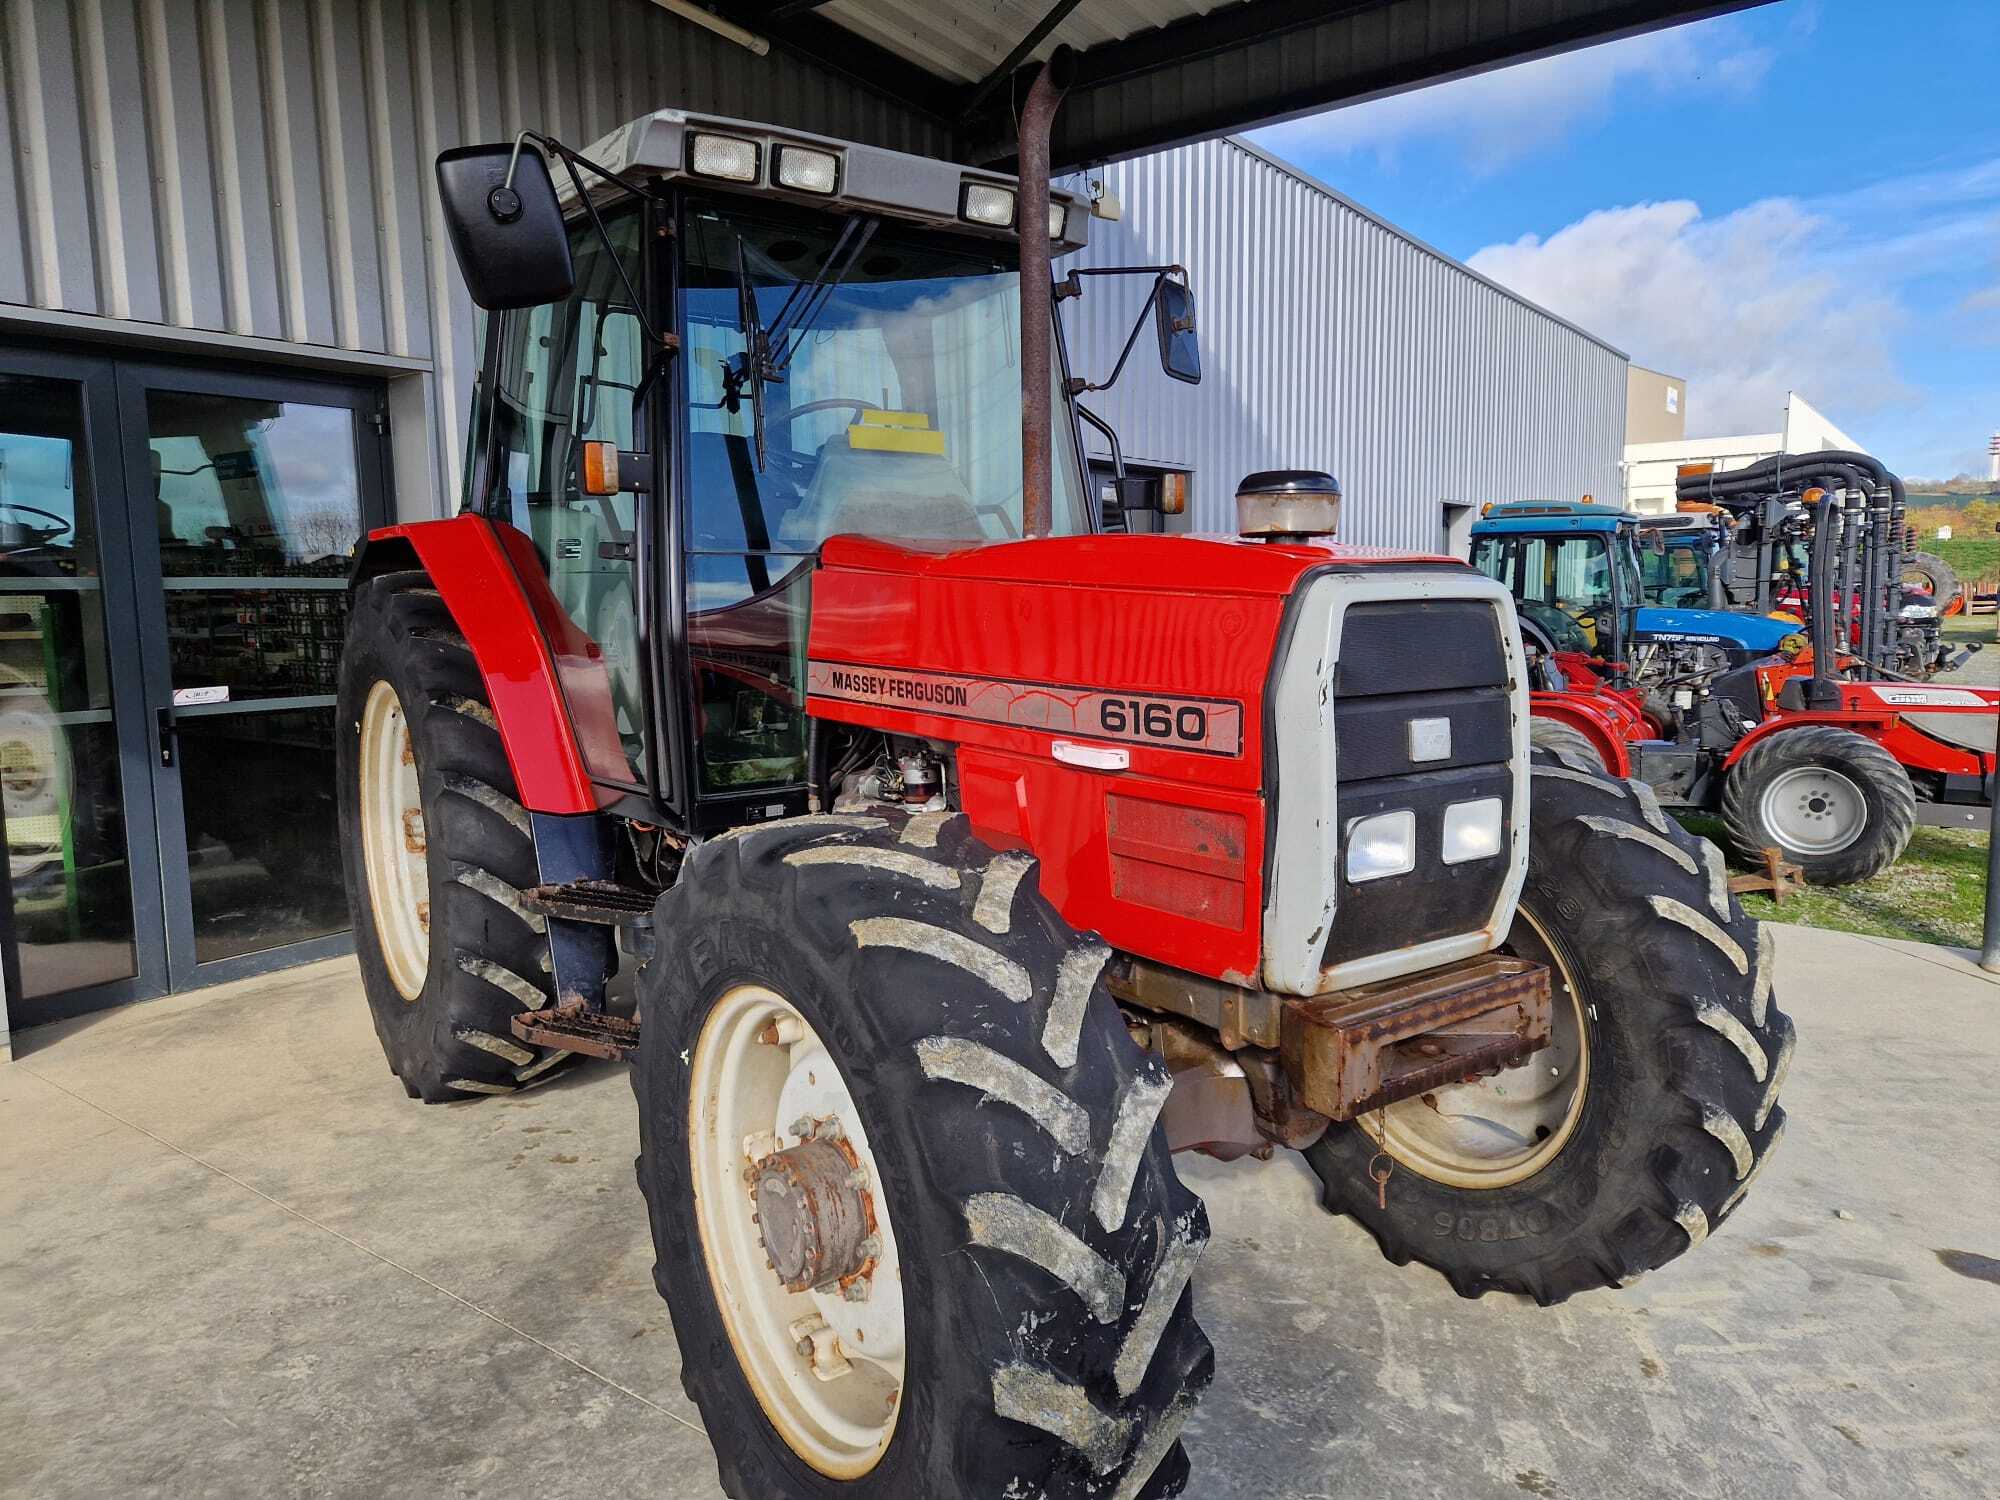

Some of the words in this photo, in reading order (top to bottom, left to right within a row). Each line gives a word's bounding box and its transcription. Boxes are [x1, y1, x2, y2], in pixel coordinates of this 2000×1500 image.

[832, 671, 886, 695] MASSEY
[889, 679, 967, 706] FERGUSON
[1101, 699, 1206, 741] 6160
